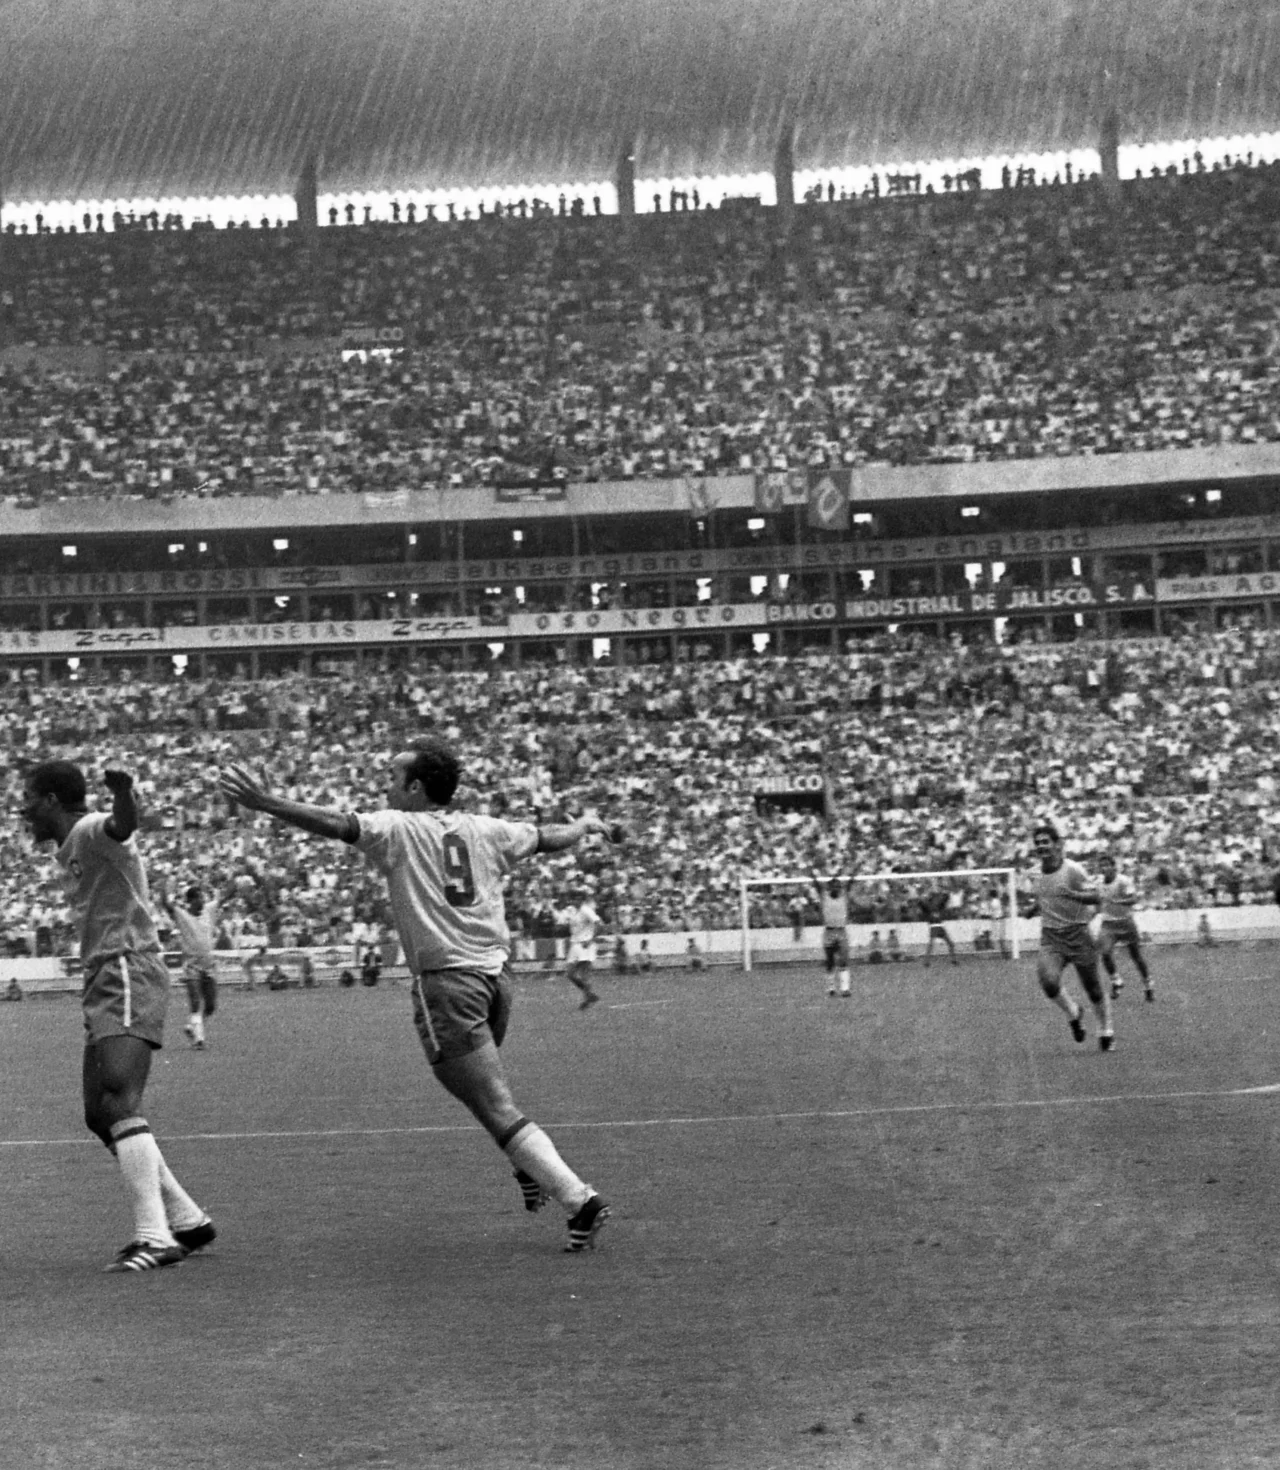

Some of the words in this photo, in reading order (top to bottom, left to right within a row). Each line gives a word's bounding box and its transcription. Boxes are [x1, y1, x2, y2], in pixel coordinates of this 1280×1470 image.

[160, 569, 261, 593] ROSSI
[769, 602, 837, 622] BANCO
[846, 595, 964, 618] INDUSTRIAL
[971, 593, 996, 611] DE
[208, 624, 356, 642] CAMISETAS
[442, 833, 476, 908] 9
